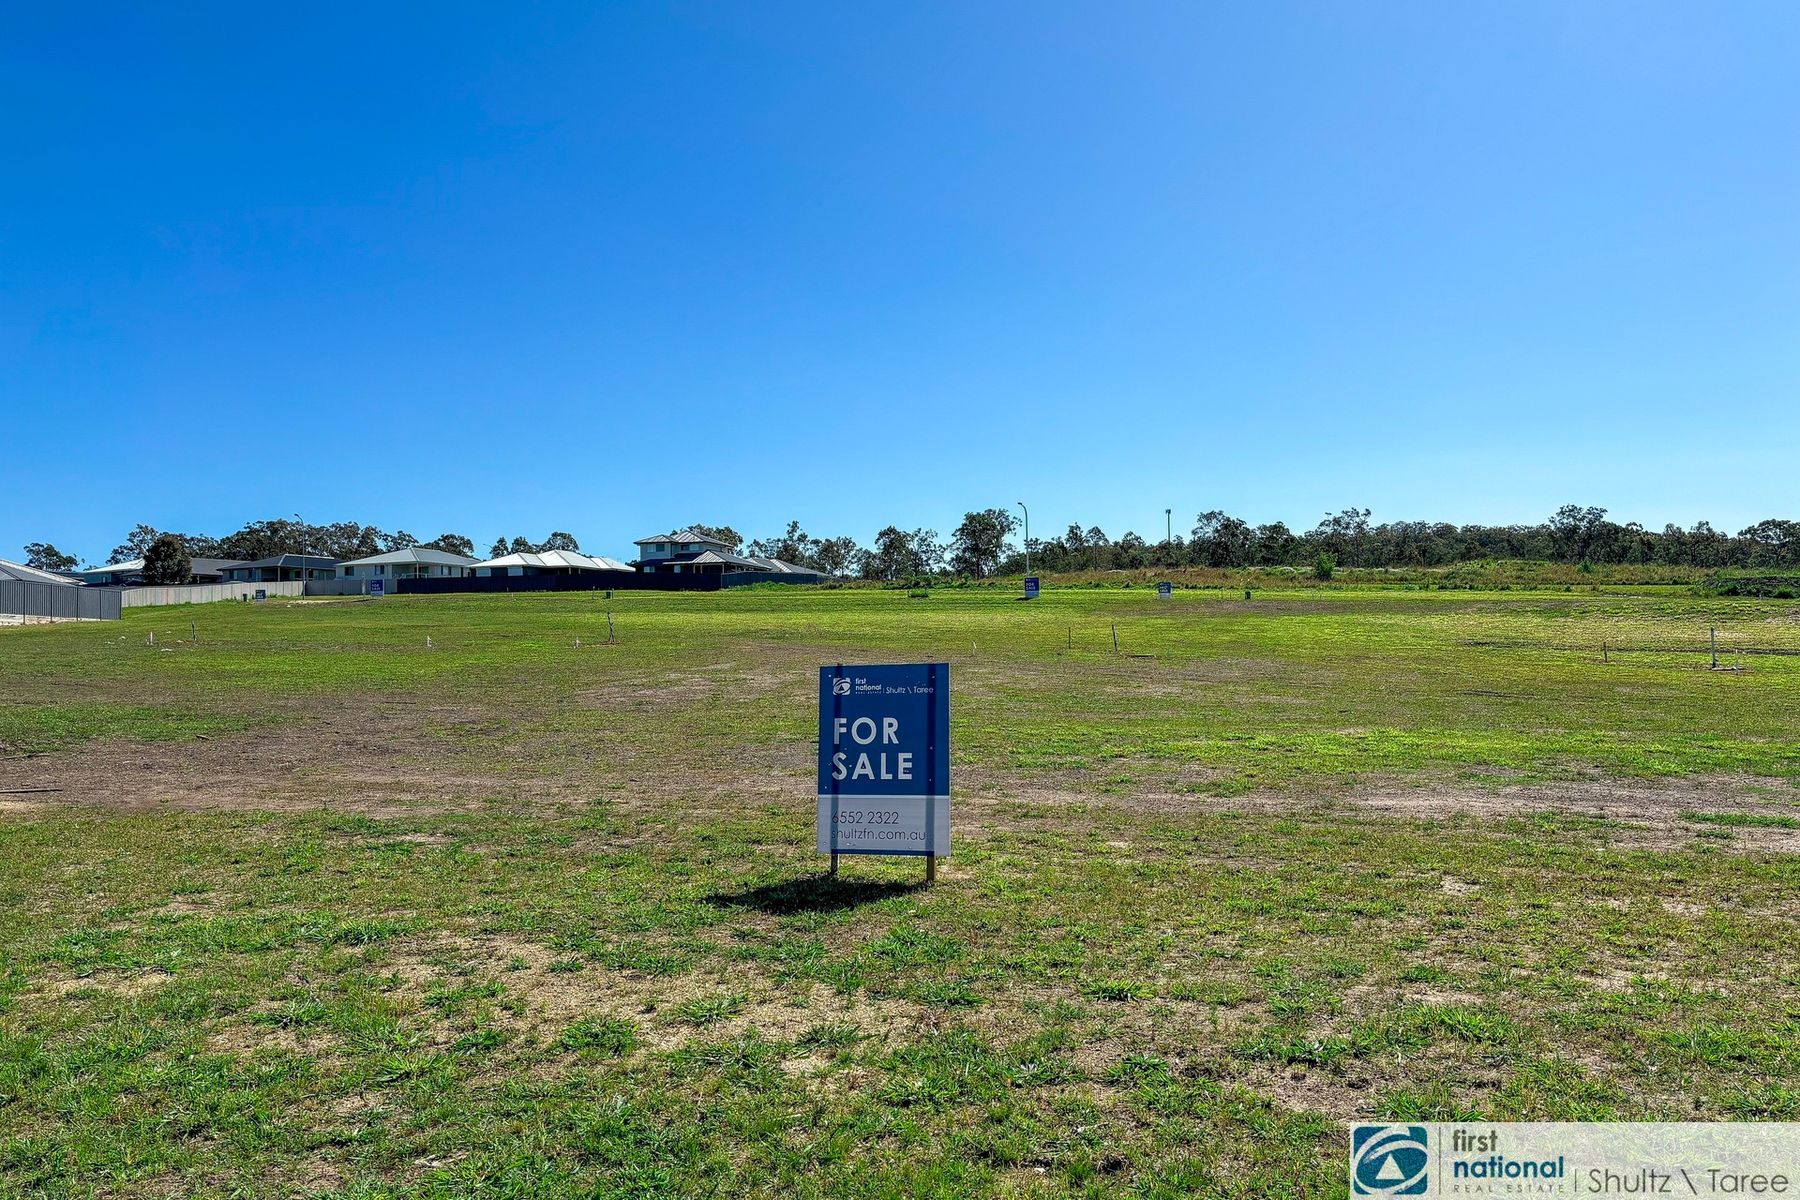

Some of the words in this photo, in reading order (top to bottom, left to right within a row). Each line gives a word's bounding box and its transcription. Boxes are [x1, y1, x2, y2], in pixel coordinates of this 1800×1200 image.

[885, 686, 906, 694] Shultz
[913, 686, 934, 694] Taree
[833, 717, 899, 745] FOR
[832, 752, 913, 780] SALE
[832, 811, 863, 824] 6552
[867, 811, 899, 825] 2322
[831, 828, 926, 841] shultzfn.com.au
